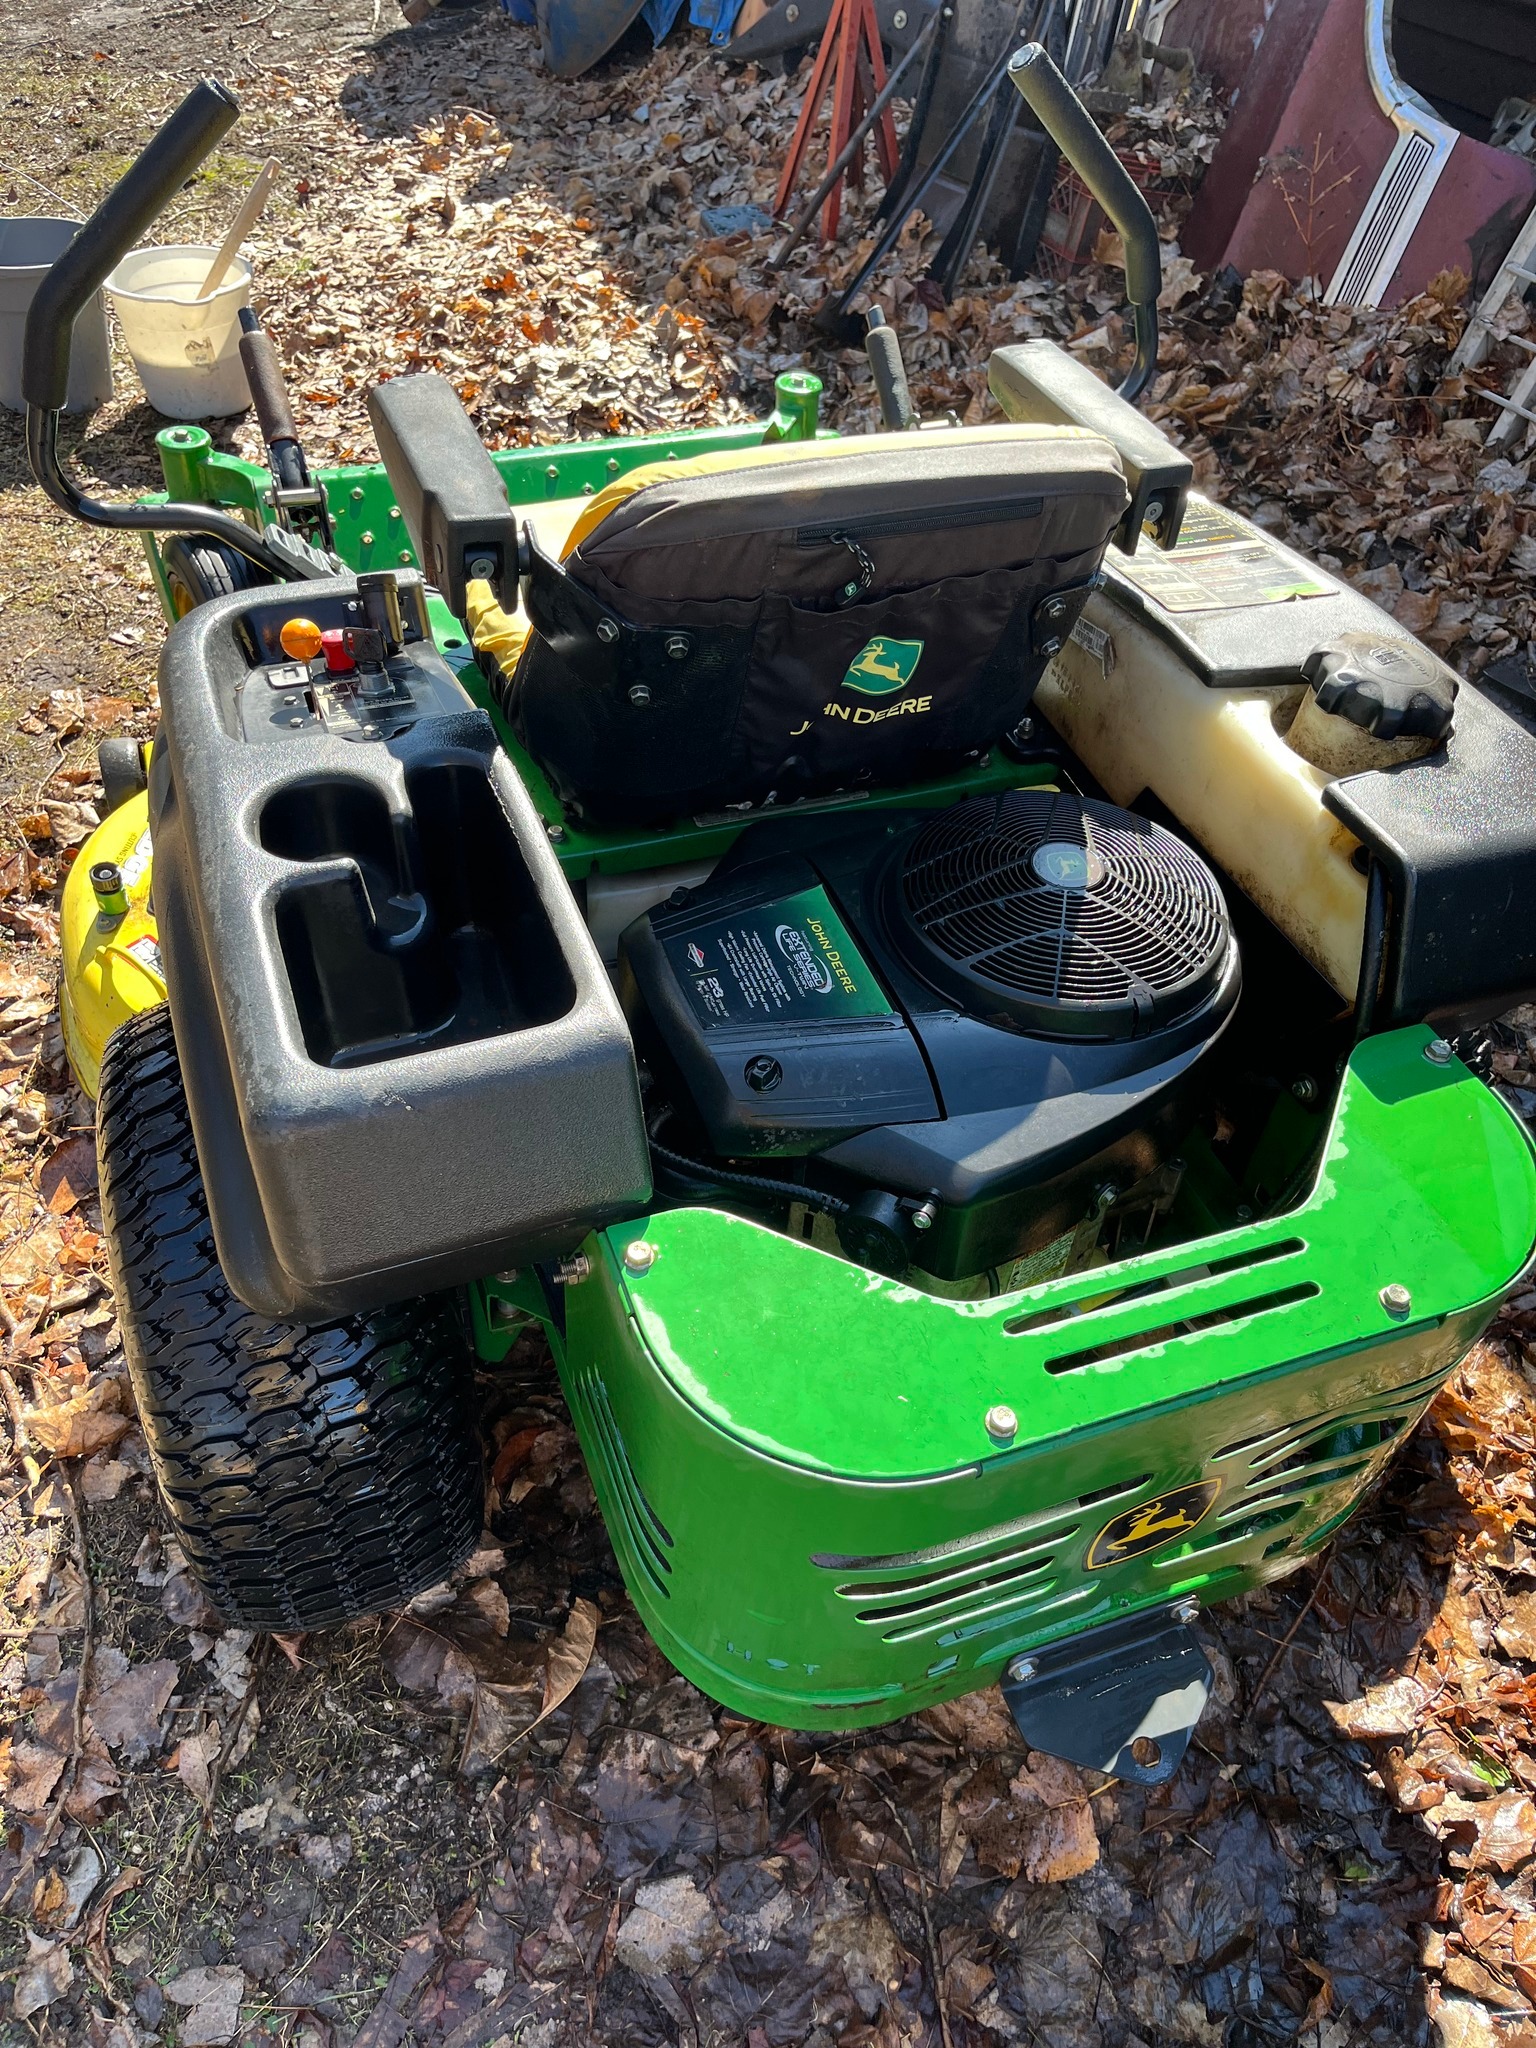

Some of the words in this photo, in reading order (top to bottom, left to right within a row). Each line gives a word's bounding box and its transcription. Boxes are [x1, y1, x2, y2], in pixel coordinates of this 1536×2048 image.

[790, 703, 851, 735] JHN
[853, 695, 933, 724] DEERE
[782, 932, 797, 952] LIFE
[793, 953, 816, 988] SERIES
[789, 931, 825, 987] EXTENDED
[806, 918, 832, 950] JOHN
[826, 951, 857, 994] DEERE
[707, 977, 724, 998] 23
[787, 965, 806, 998] TECHNOLOGY
[794, 963, 809, 990] V-TWIN
